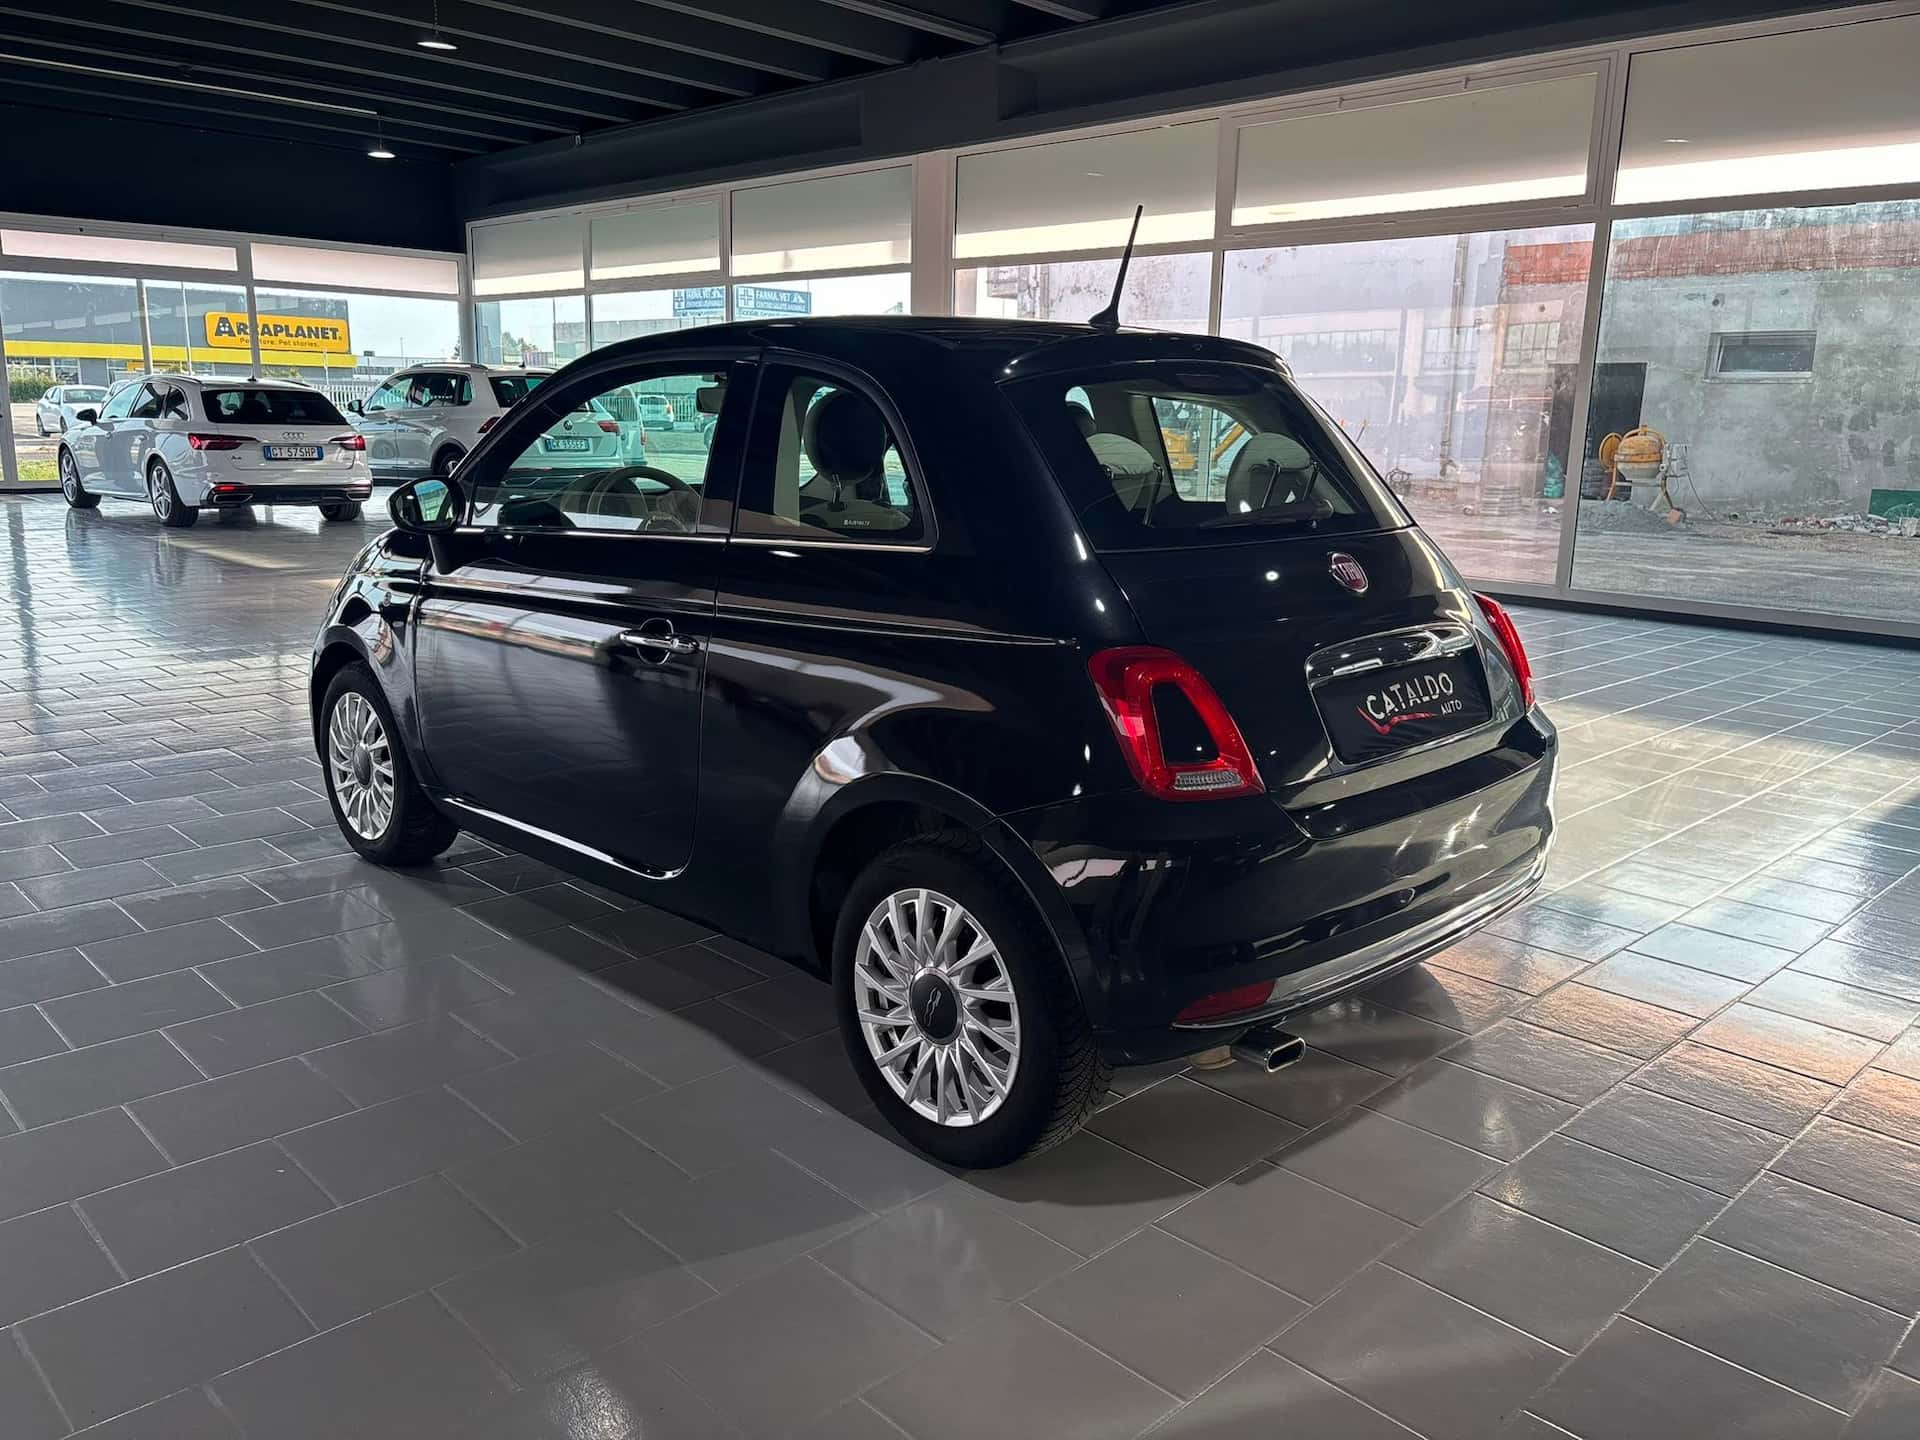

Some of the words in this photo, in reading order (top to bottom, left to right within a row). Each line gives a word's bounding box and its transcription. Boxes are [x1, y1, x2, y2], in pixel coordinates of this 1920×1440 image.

[215, 316, 339, 340] ARAPLANET
[1335, 561, 1361, 581] FIAT
[1366, 672, 1454, 719] CATALDO
[1441, 699, 1462, 715] AUTO
